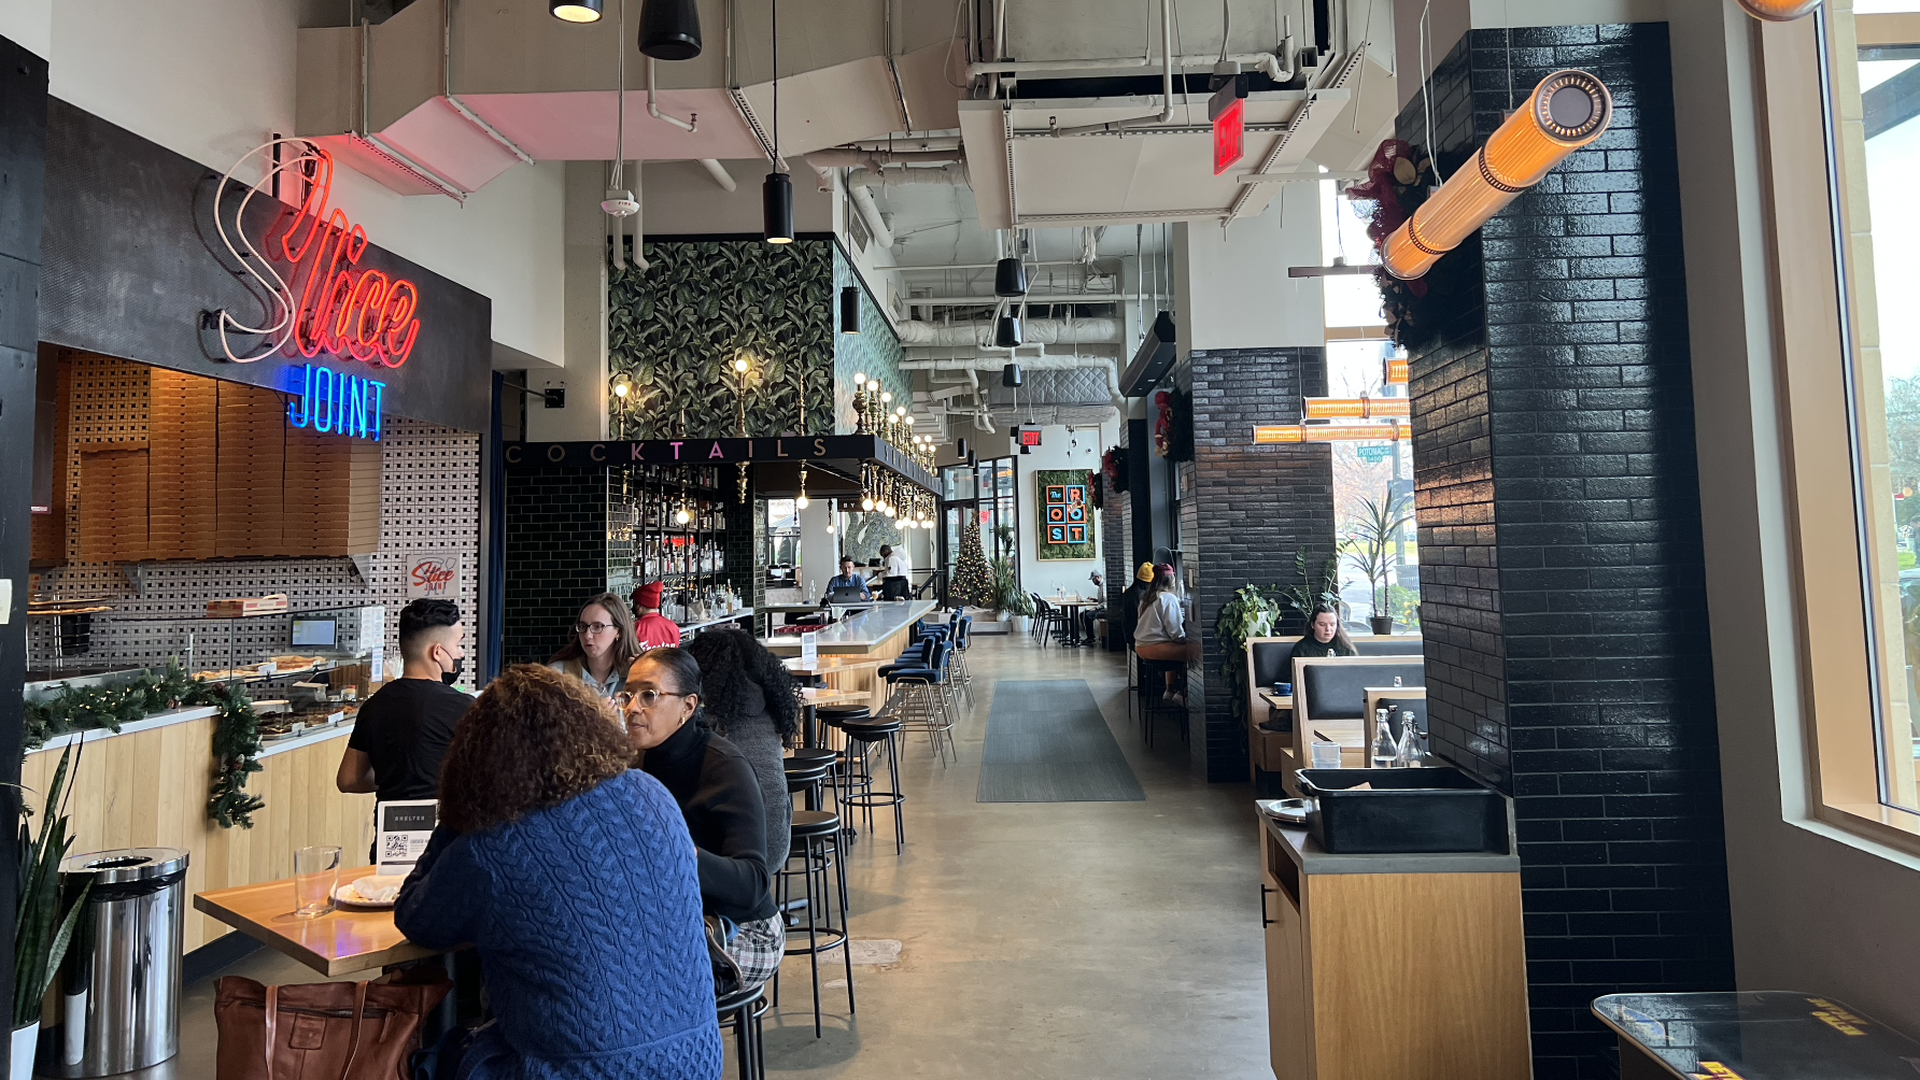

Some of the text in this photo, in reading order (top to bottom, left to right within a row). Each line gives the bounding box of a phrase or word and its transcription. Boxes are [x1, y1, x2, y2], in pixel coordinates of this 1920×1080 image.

[213, 136, 421, 369] Slice
[286, 363, 387, 442] JOINT
[504, 438, 827, 464] COCKTAILS
[1022, 432, 1040, 446] EXIT
[1358, 447, 1385, 456] POTOMAC
[411, 561, 455, 587] Slice
